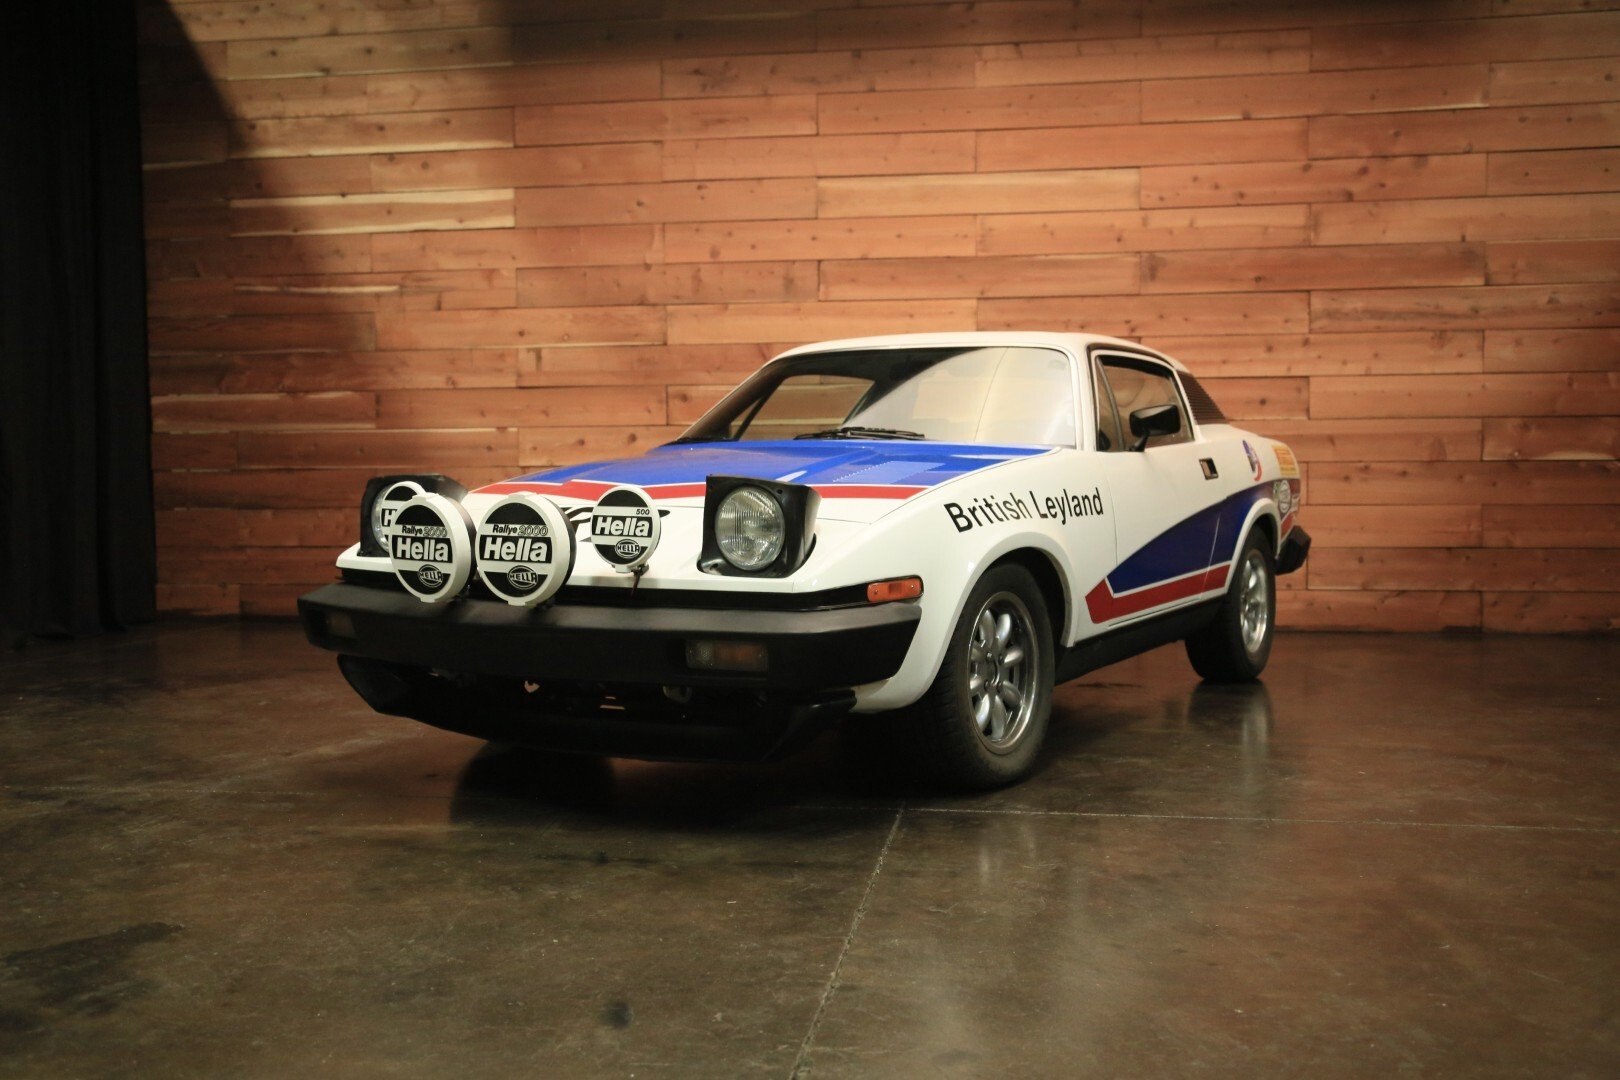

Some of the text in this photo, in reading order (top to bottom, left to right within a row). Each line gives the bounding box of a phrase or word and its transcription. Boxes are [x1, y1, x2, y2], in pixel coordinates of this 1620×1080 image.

[635, 508, 650, 516] 500
[943, 487, 1104, 533] British Leyland
[402, 525, 448, 538] Rallye 2000
[492, 524, 549, 537] Rallye 2000
[595, 516, 650, 537] Hella
[396, 536, 449, 562] Hella
[483, 536, 548, 562] Hella
[616, 543, 640, 554] HELLA
[509, 572, 538, 584] HELLA
